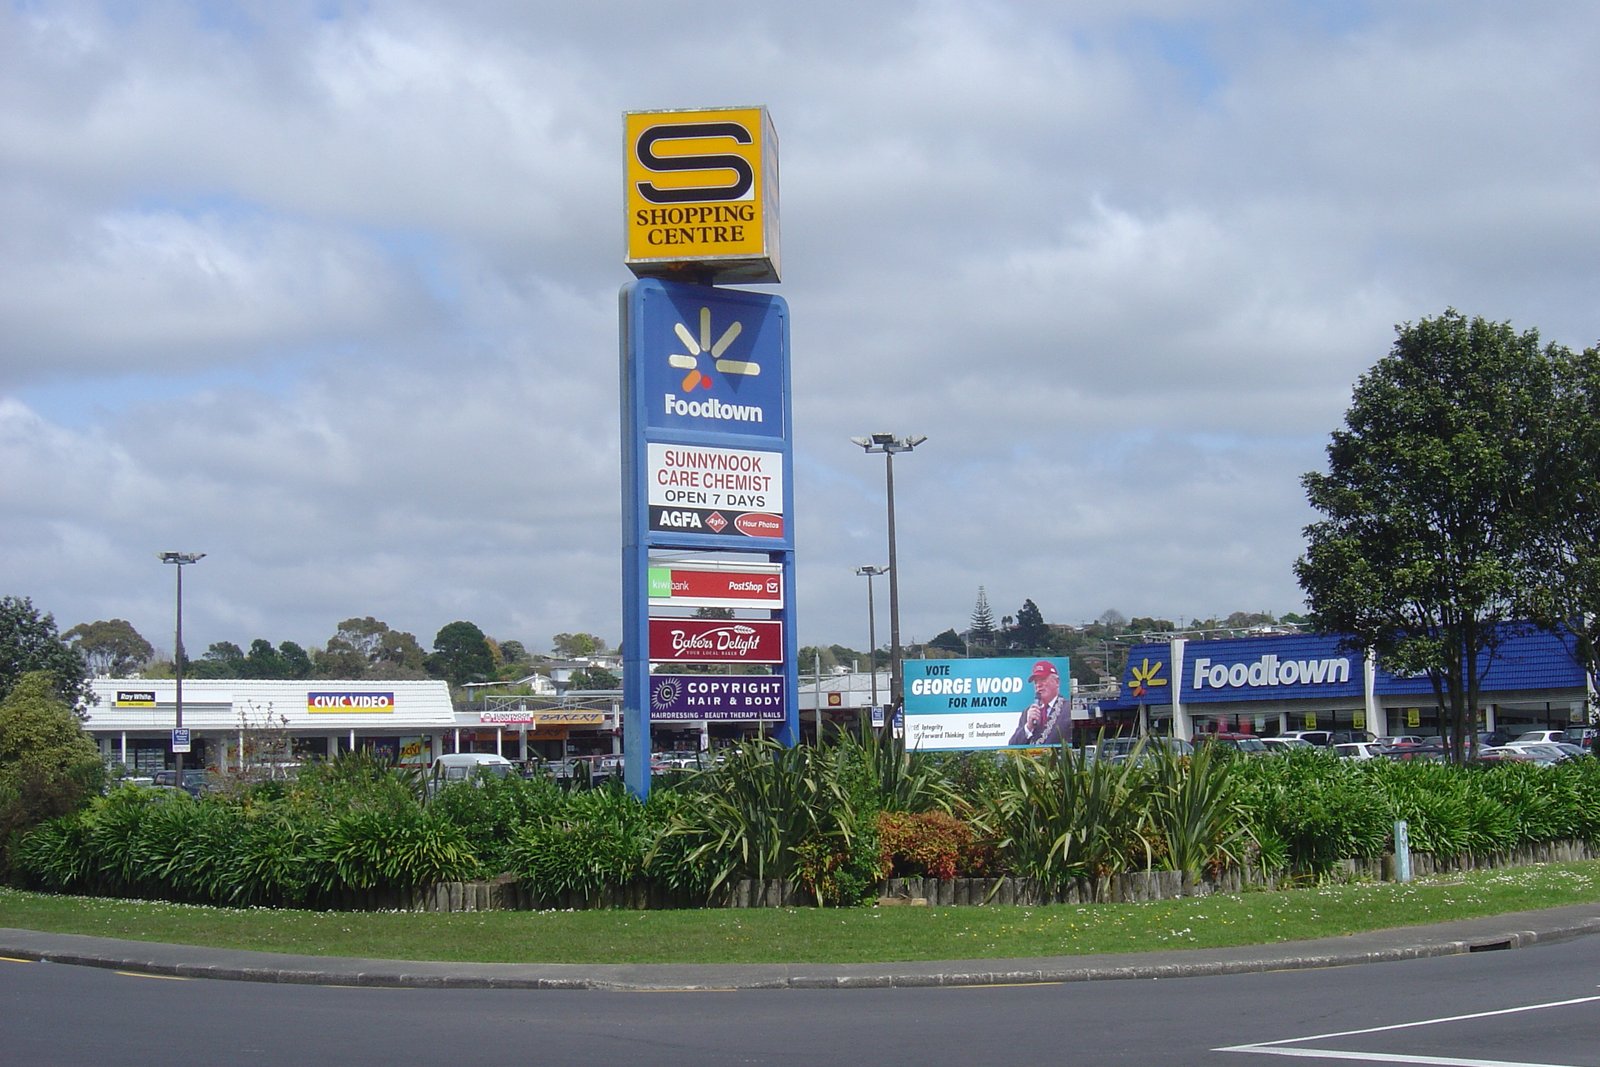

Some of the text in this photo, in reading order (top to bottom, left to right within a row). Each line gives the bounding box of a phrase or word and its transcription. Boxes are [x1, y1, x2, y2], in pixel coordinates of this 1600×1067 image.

[636, 205, 755, 226] SHOPPING
[647, 225, 745, 246] CENTRE
[664, 393, 763, 422] Foodtown
[665, 450, 762, 472] SUNNYNOOK
[657, 469, 771, 492] CARE CHEMIST
[665, 490, 766, 507] OPEN 7 DAYS
[659, 510, 702, 528] AGFA
[742, 520, 758, 528] Hour
[758, 521, 779, 529] Photos
[652, 579, 689, 591] kiwibank
[728, 581, 763, 593] PostShop
[670, 630, 761, 656] Bakers Delight
[925, 665, 950, 676] VOTE
[1193, 654, 1350, 690] Foodtown
[687, 682, 781, 694] COPYRIGHT
[911, 677, 1023, 695] GEORGE WOOD
[314, 695, 389, 708] CIVIC VIDEO
[687, 696, 781, 706] HAIR & BODY
[948, 696, 1008, 708] FOR MAYOR
[651, 711, 699, 719] HAIRDRESSING
[704, 711, 728, 719] BEAUTY
[729, 711, 758, 719] THERAPY
[763, 711, 781, 719] NAILS
